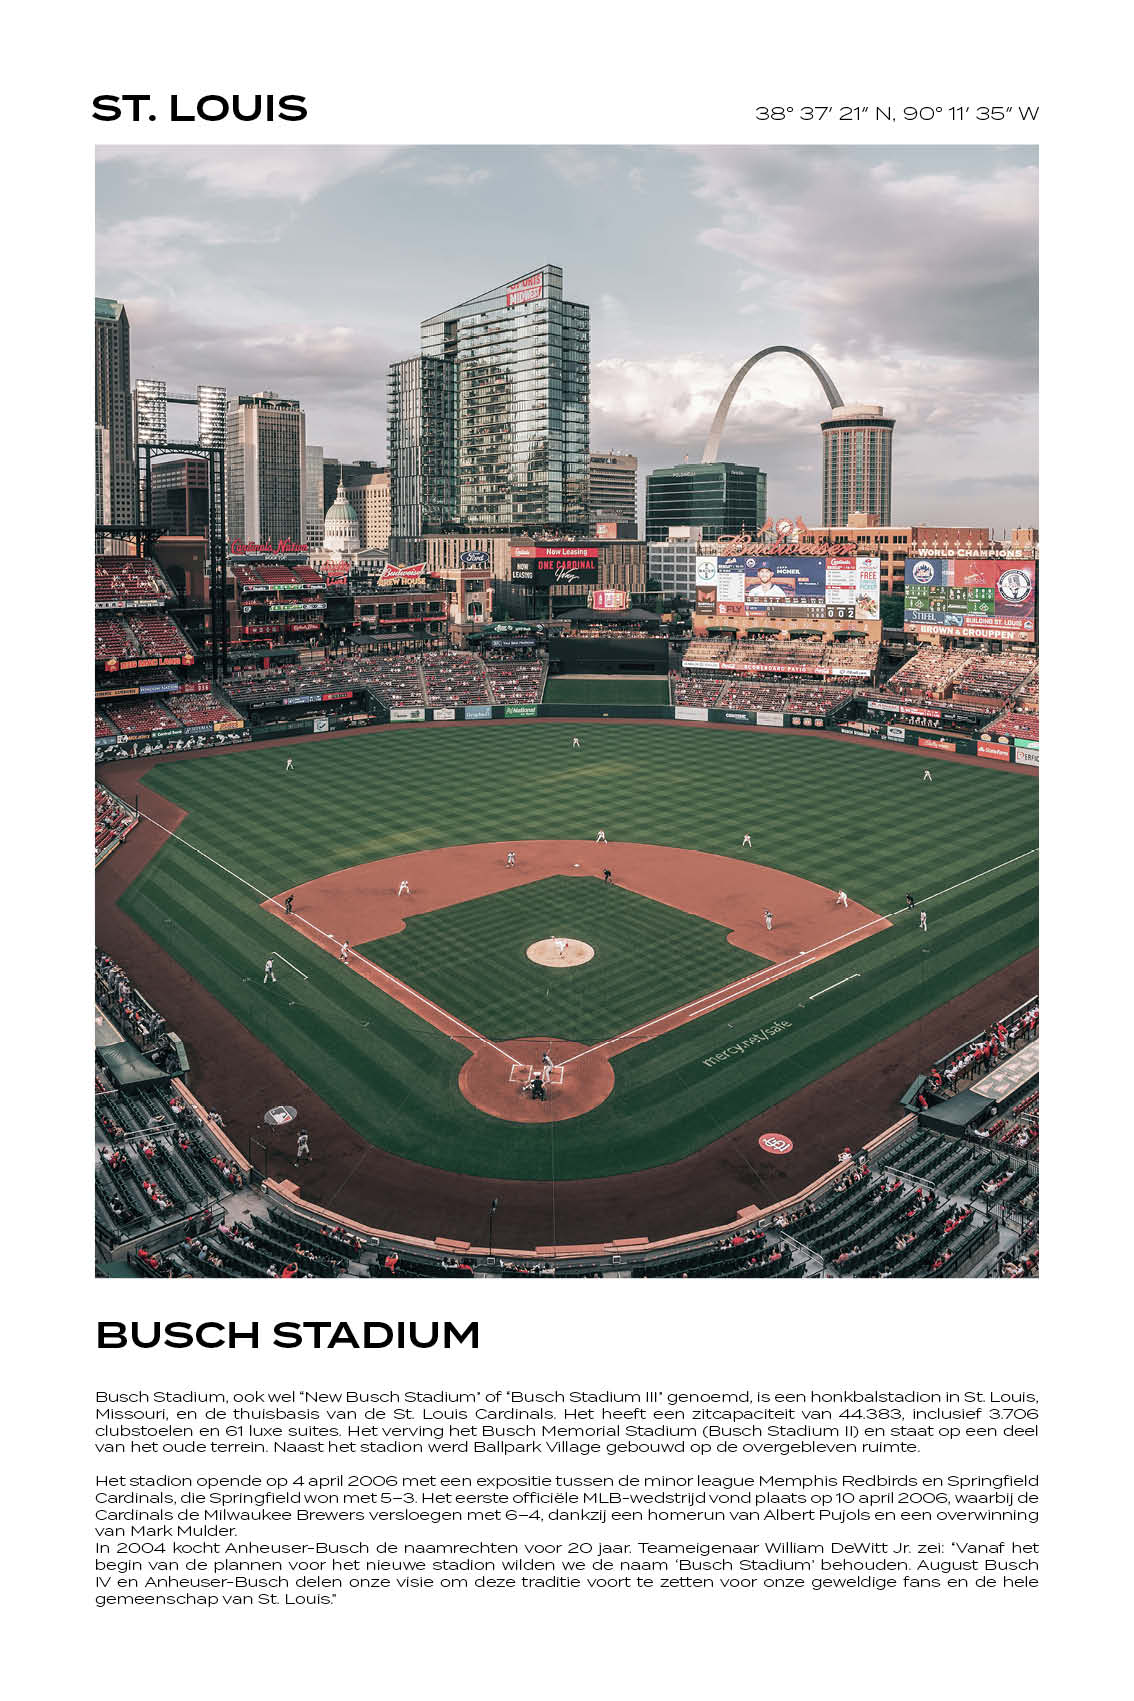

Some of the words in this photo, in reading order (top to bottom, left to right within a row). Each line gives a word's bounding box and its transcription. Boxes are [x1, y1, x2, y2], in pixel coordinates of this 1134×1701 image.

[231, 539, 272, 554] Cardinals
[273, 539, 308, 554] Nation
[717, 535, 855, 557] Budweiser
[562, 548, 587, 556] Leasing
[957, 549, 1022, 557] CHAMPIONS
[465, 552, 485, 563] Ford
[538, 560, 554, 570] ONE
[556, 560, 595, 570] CARDINAL
[386, 567, 424, 578] Budweiser
[554, 567, 580, 583] Way
[402, 577, 426, 585] HOUSE
[838, 610, 844, 618] 0
[848, 610, 854, 618] 2
[912, 611, 936, 621] STIFEL
[920, 625, 953, 633] BROWN
[962, 628, 1014, 638] CROUPPEN
[702, 1020, 792, 1068] mercy.net/safe
